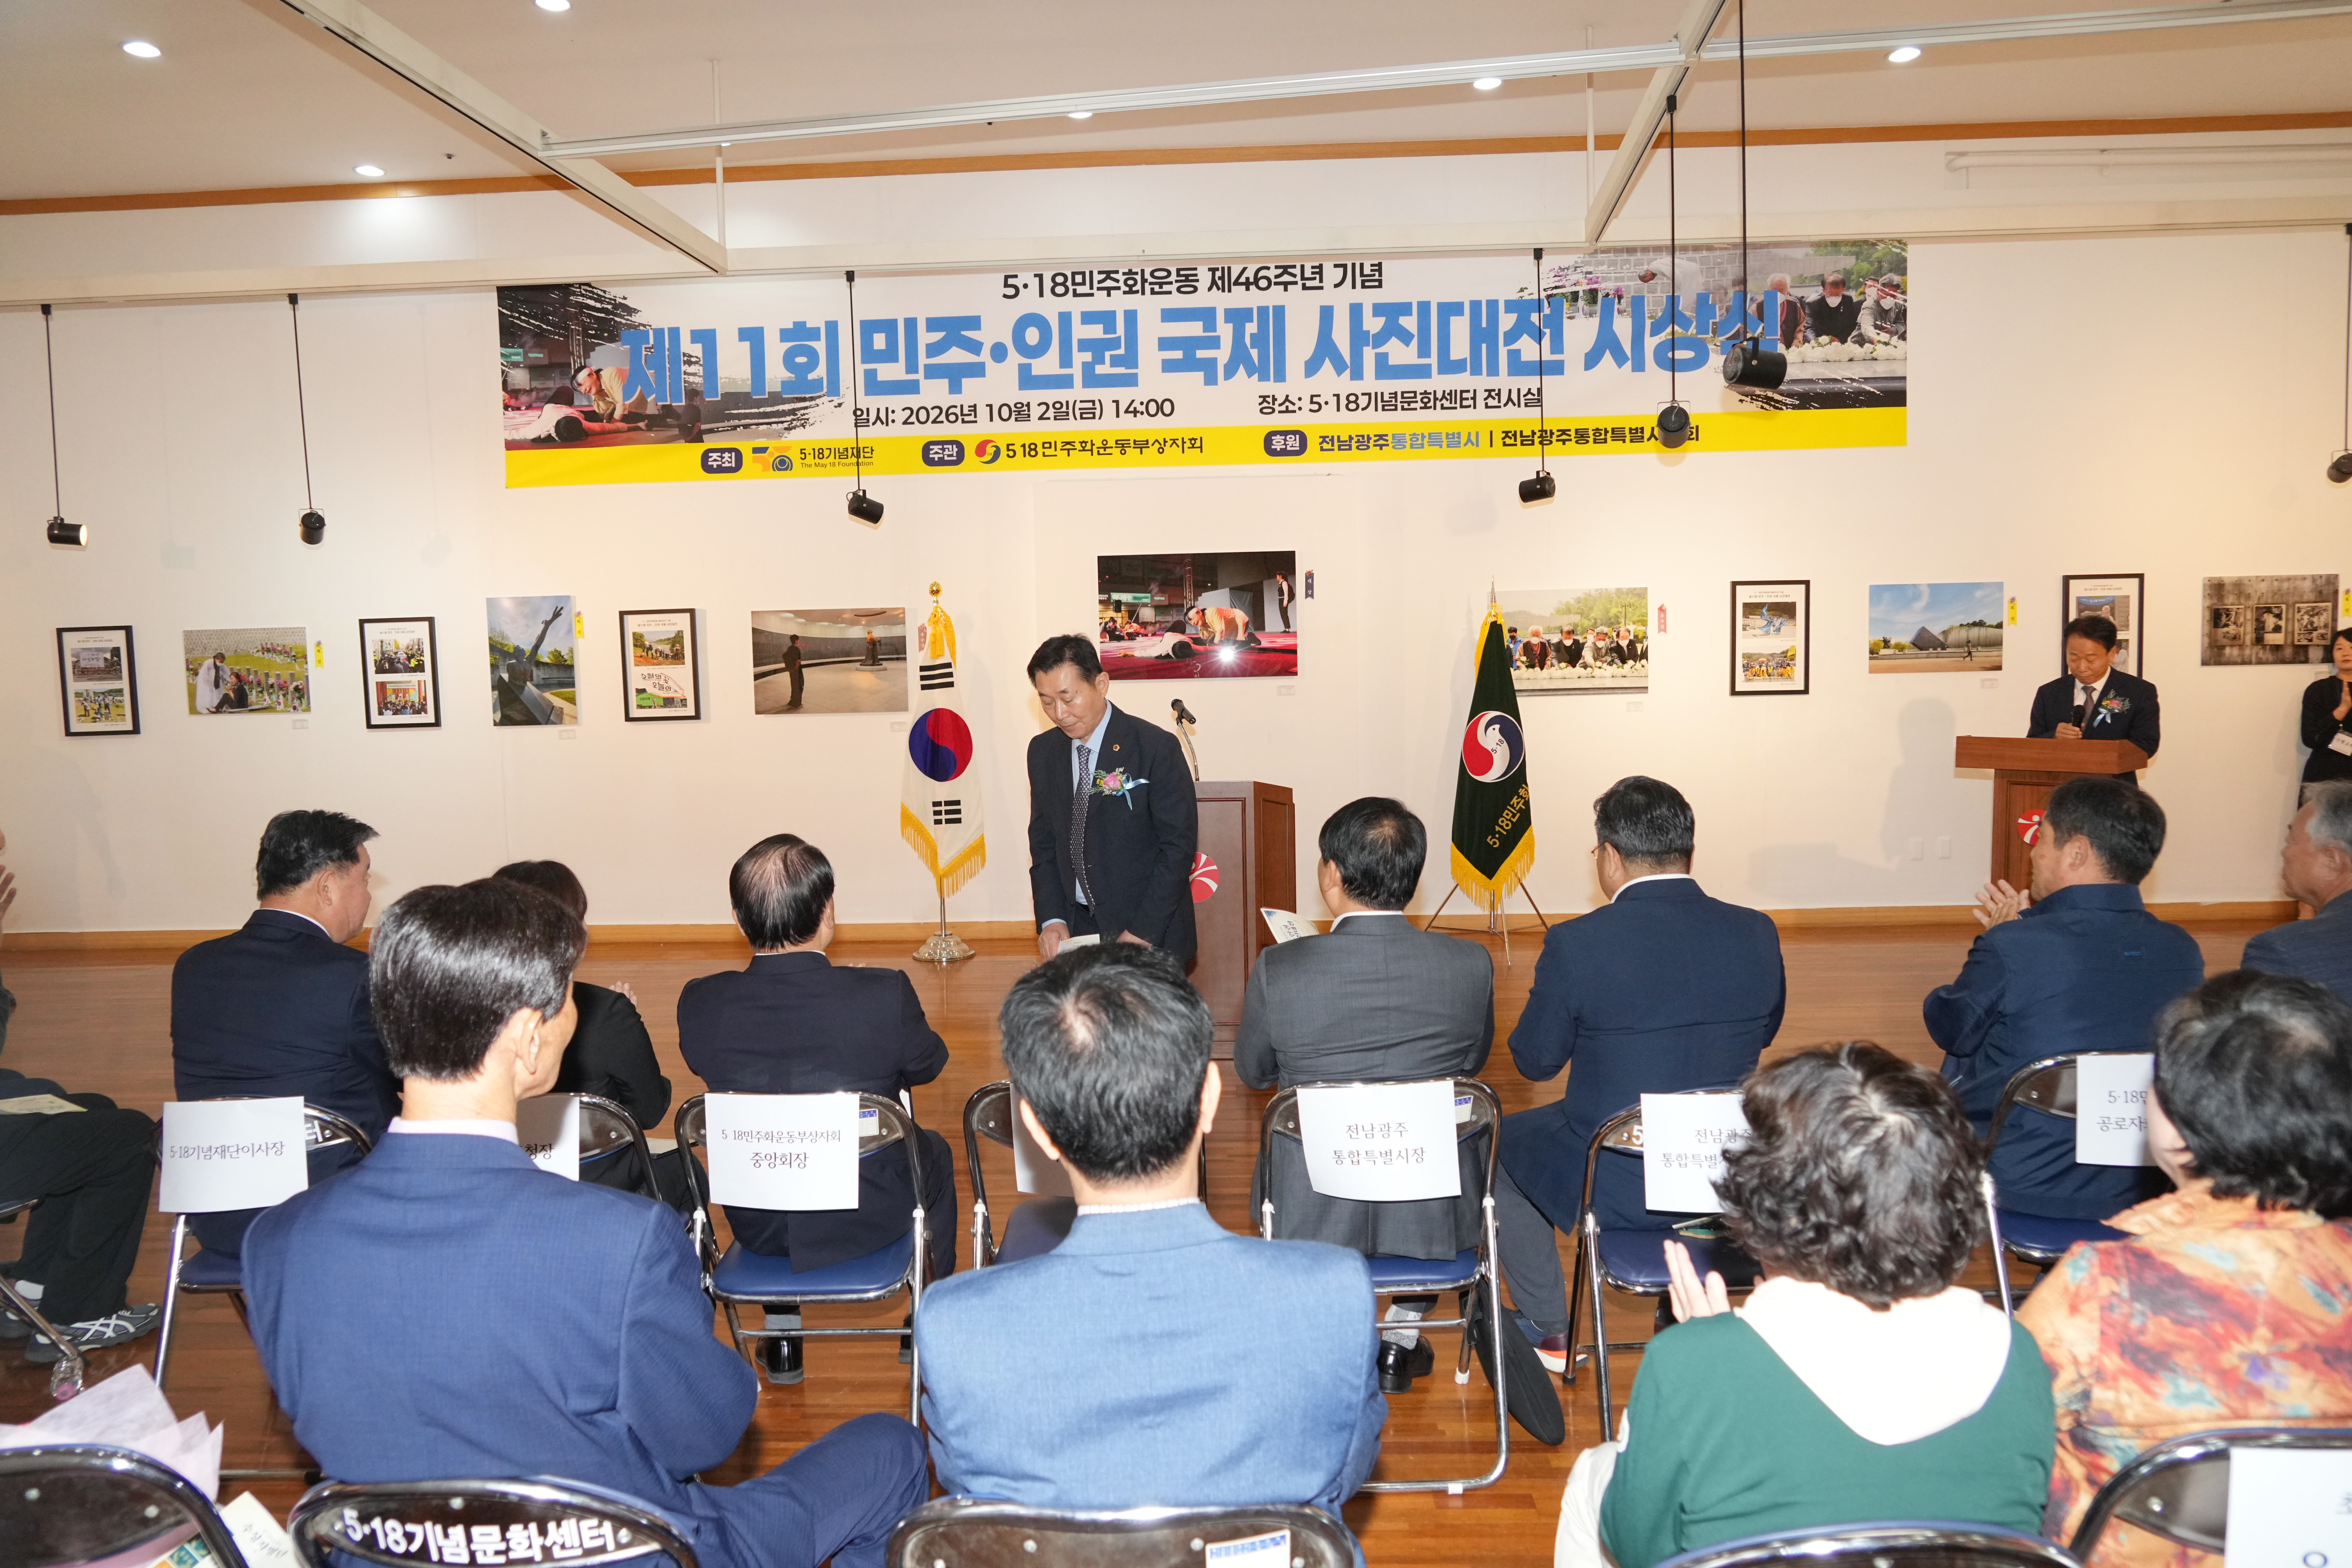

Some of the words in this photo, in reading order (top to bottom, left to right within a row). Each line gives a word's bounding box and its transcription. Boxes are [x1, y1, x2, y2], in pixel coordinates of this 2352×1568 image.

[1002, 267, 1200, 299] 5·18민주화운동
[1207, 263, 1325, 294] 제46주년
[1335, 262, 1383, 290] 기념
[621, 320, 838, 405] 제11회
[859, 309, 1139, 396] 민주·인권
[1158, 304, 1286, 386] 국제
[1305, 298, 1565, 381] 사진대전
[1584, 290, 1779, 373] 시상식
[1258, 393, 1302, 415] 장소:
[1309, 389, 1478, 413] 5·18기념문화센터
[1483, 387, 1542, 409] 전시실
[853, 406, 895, 428] 일시:
[902, 404, 979, 426] 2026년
[985, 401, 1032, 423] 10월
[1038, 398, 1104, 421] 2일(금)
[1112, 398, 1175, 419] 14:00
[1271, 434, 1300, 452] 후원
[1319, 430, 1480, 451] 전남광주통합특별시
[708, 452, 735, 469] 주최
[800, 446, 874, 460] 5·18기념재단
[929, 445, 958, 461] 주관
[1308, 578, 1312, 595] 대상
[1491, 738, 1504, 754] 5·18
[1345, 1122, 1409, 1140] 전남광주
[170, 1141, 285, 1161] 5·18기념재단이사장
[749, 1151, 809, 1170] 중앙회장
[1331, 1147, 1426, 1166] 통합특별시장
[1661, 1152, 1723, 1168] 통합특별
[342, 1509, 616, 1564] 5·18기념문화센터
